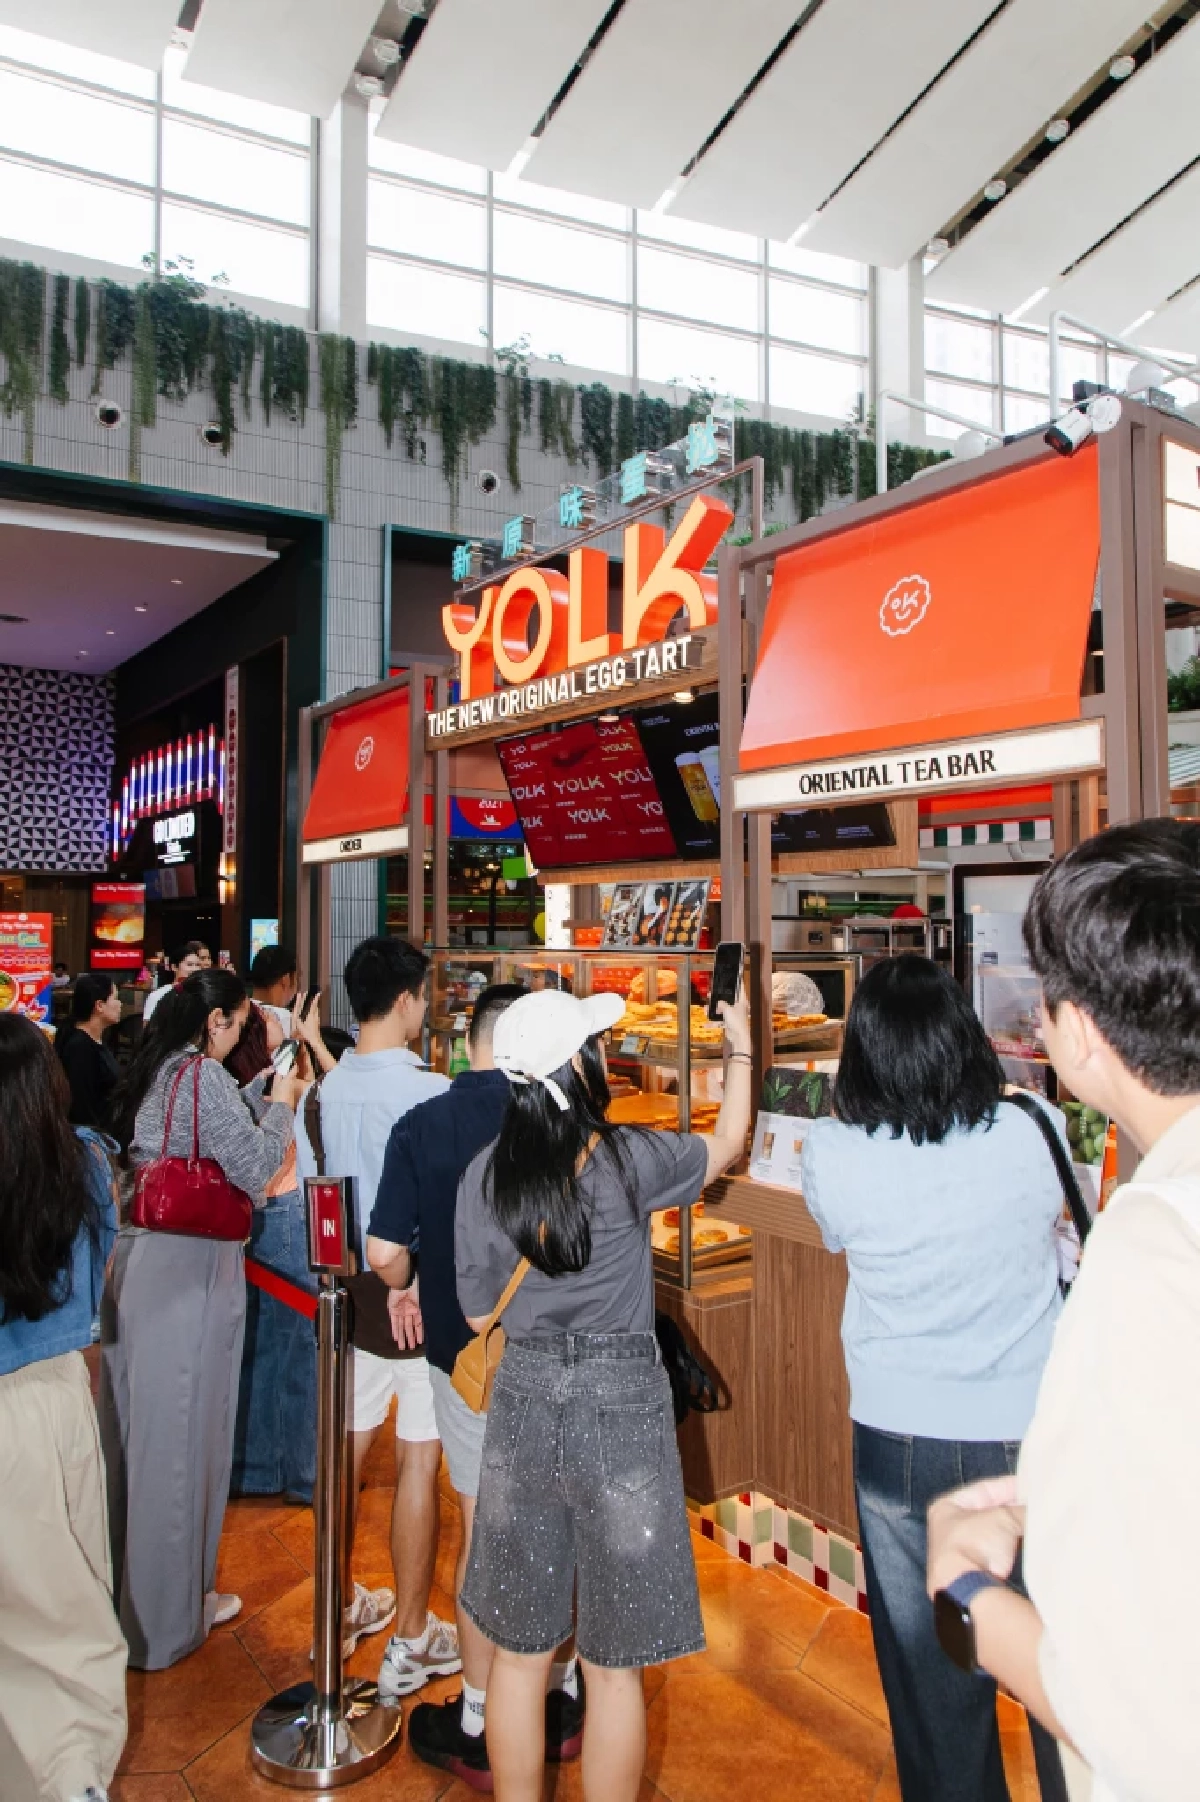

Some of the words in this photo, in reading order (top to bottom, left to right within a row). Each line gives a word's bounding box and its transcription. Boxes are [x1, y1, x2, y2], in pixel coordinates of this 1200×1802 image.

[442, 494, 732, 700] YOLK
[427, 707, 456, 738] THE
[458, 696, 495, 730] NEW
[498, 671, 582, 717] ORIGINAL
[585, 656, 626, 694] EGG
[632, 634, 692, 680] TART
[553, 775, 605, 795] YOLK
[799, 764, 894, 795] ORIENTAL
[897, 757, 943, 784] TEA
[946, 749, 997, 777] BAR
[567, 807, 612, 825] YOLK
[323, 1218, 337, 1238] IN
